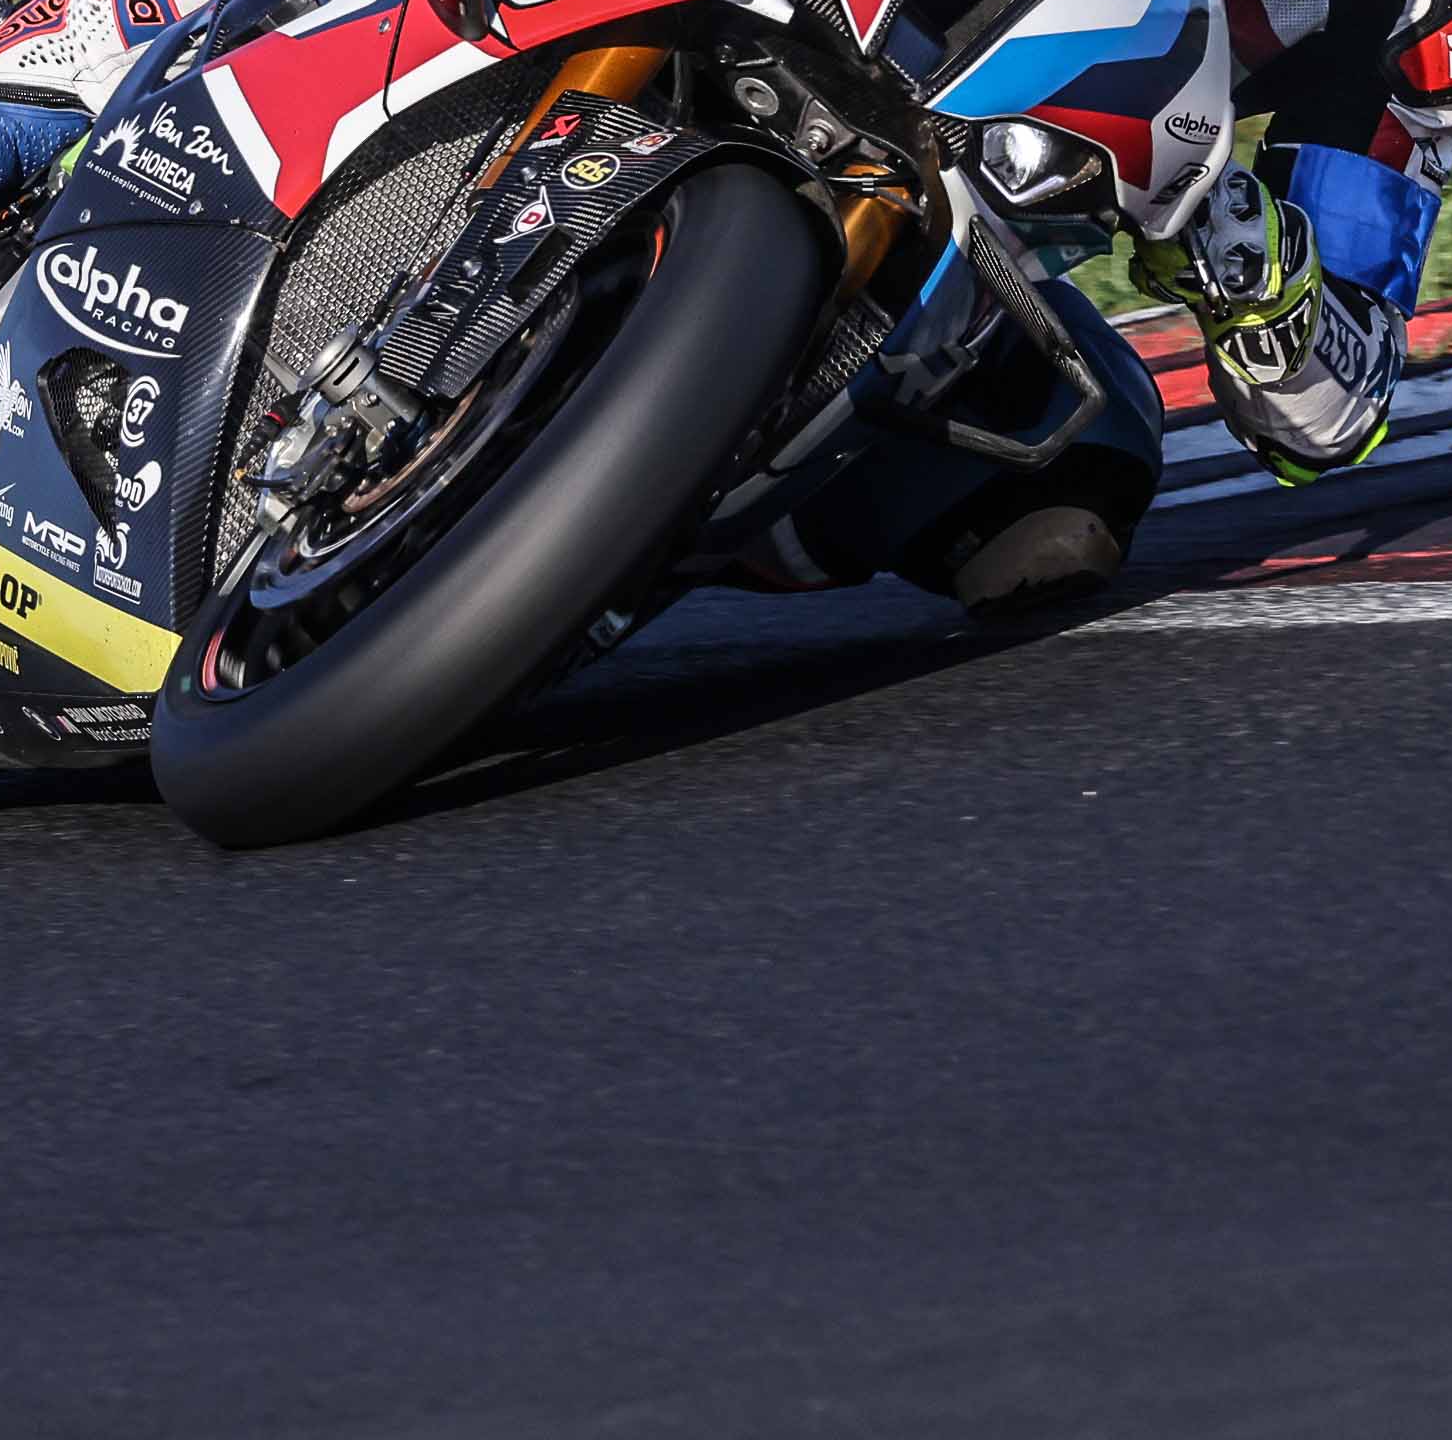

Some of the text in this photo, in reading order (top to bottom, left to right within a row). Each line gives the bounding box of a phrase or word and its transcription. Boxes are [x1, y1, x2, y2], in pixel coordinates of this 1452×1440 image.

[1172, 112, 1220, 136] alpha
[136, 147, 196, 195] HORECA
[50, 246, 190, 333] alpha
[91, 308, 176, 348] RACING
[127, 397, 155, 427] 37
[23, 511, 87, 557] MRP
